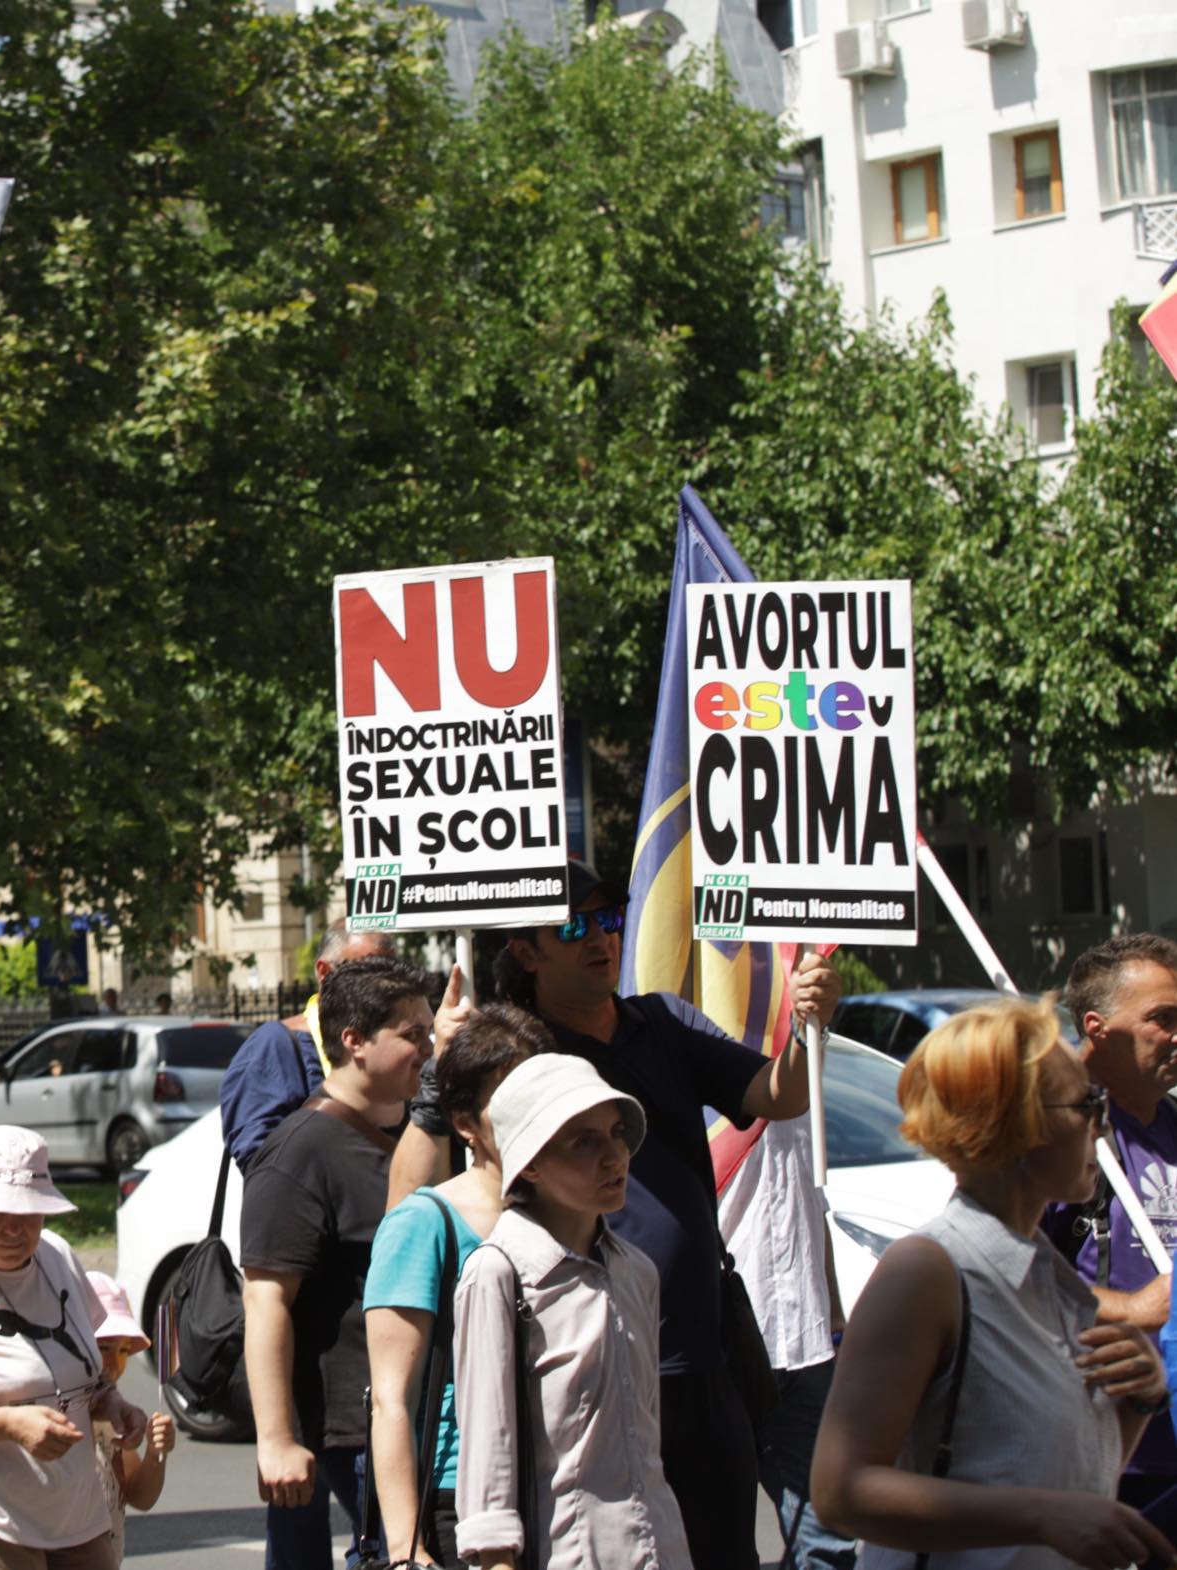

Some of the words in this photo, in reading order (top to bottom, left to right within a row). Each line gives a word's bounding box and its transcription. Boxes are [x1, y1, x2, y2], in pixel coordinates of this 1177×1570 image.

[338, 570, 550, 718] NU
[694, 591, 906, 671] AVORTUL
[694, 672, 866, 730] este
[345, 709, 554, 755] ÎNDOCTRINĂRII
[347, 748, 557, 802] SEXUALE
[348, 806, 402, 859] ÎN
[417, 804, 560, 870] ȘCOLI
[355, 878, 397, 915] ND
[402, 877, 563, 905] #PentruNormalitate
[702, 889, 744, 924] ND
[752, 896, 806, 918] Pentru
[808, 898, 905, 921] Normalitate
